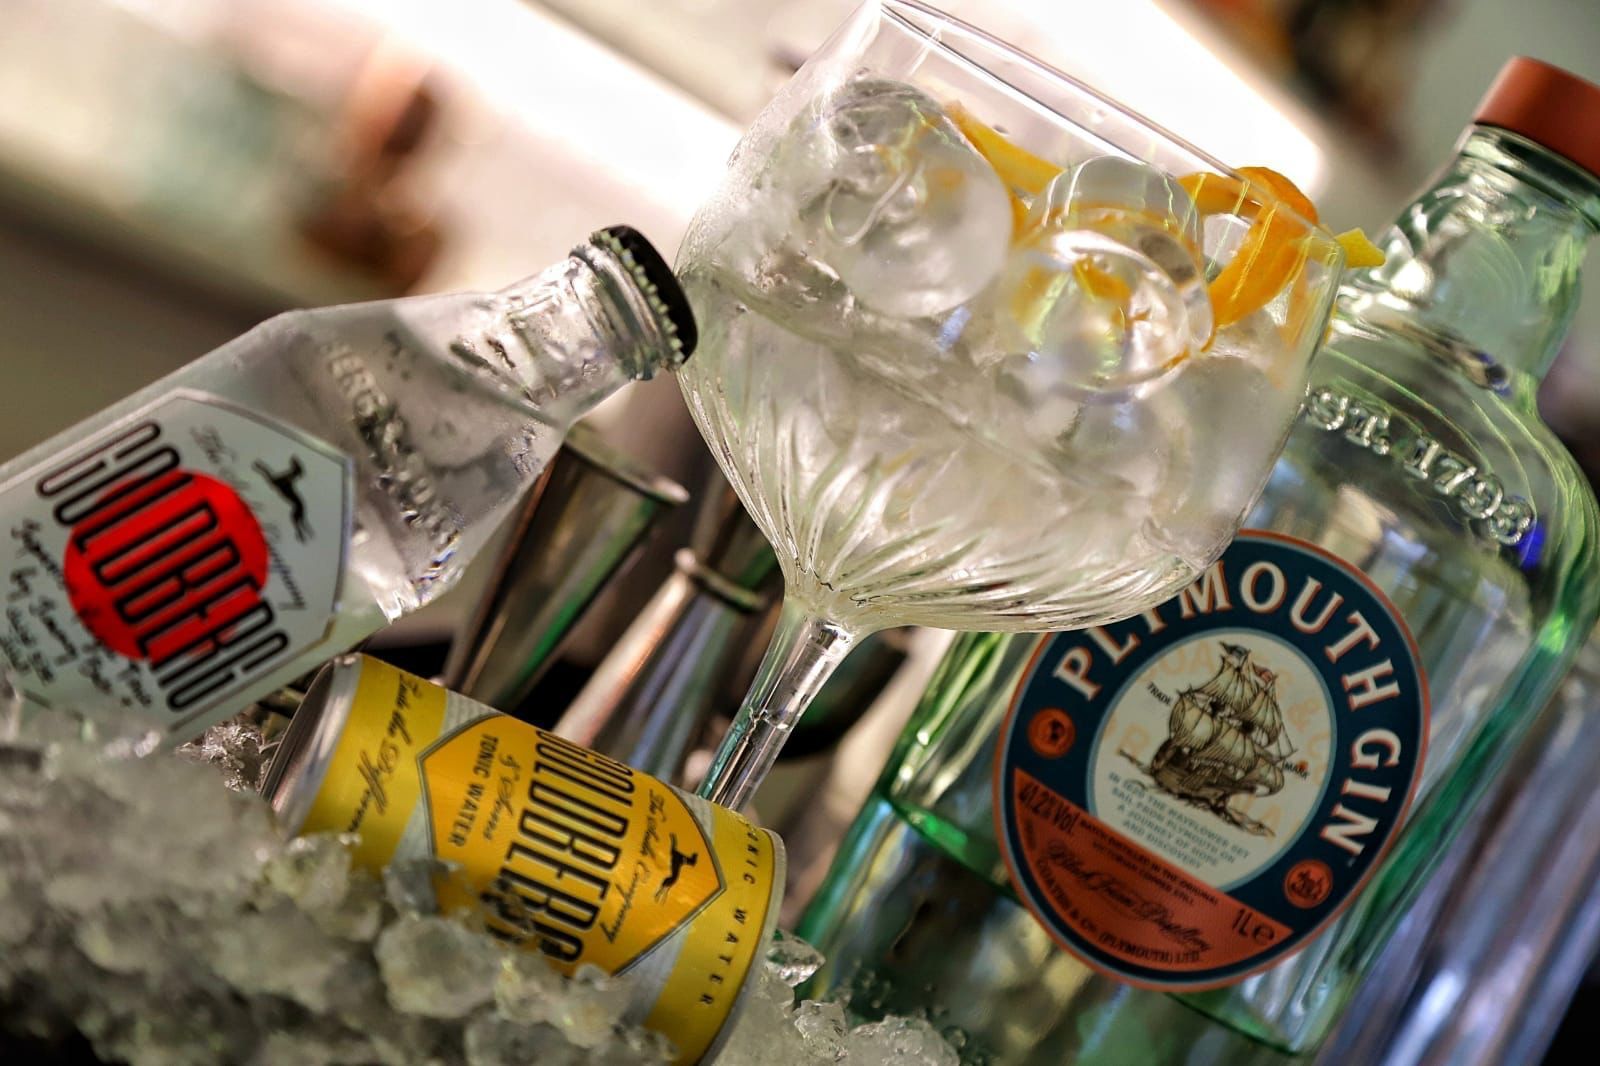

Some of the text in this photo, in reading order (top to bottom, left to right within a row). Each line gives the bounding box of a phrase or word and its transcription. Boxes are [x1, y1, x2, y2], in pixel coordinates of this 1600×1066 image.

[1304, 388, 1536, 546] ST. 1793
[36, 422, 290, 711] GOLDBERG
[1146, 681, 1174, 706] TRADE
[448, 733, 498, 848] TONIC WATER
[499, 753, 521, 781] &
[1321, 728, 1401, 857] GIN
[649, 789, 667, 823] The
[1126, 807, 1174, 841] JOURNEY
[1173, 835, 1190, 850] OF
[1135, 799, 1167, 824] FROM
[1166, 817, 1220, 855] PLYMOUTH
[1218, 849, 1236, 864] ON
[1145, 793, 1167, 812] THE
[1167, 805, 1232, 850] MAYFLOWER
[600, 860, 651, 944] Company
[700, 829, 760, 1006] ONIC WATER
